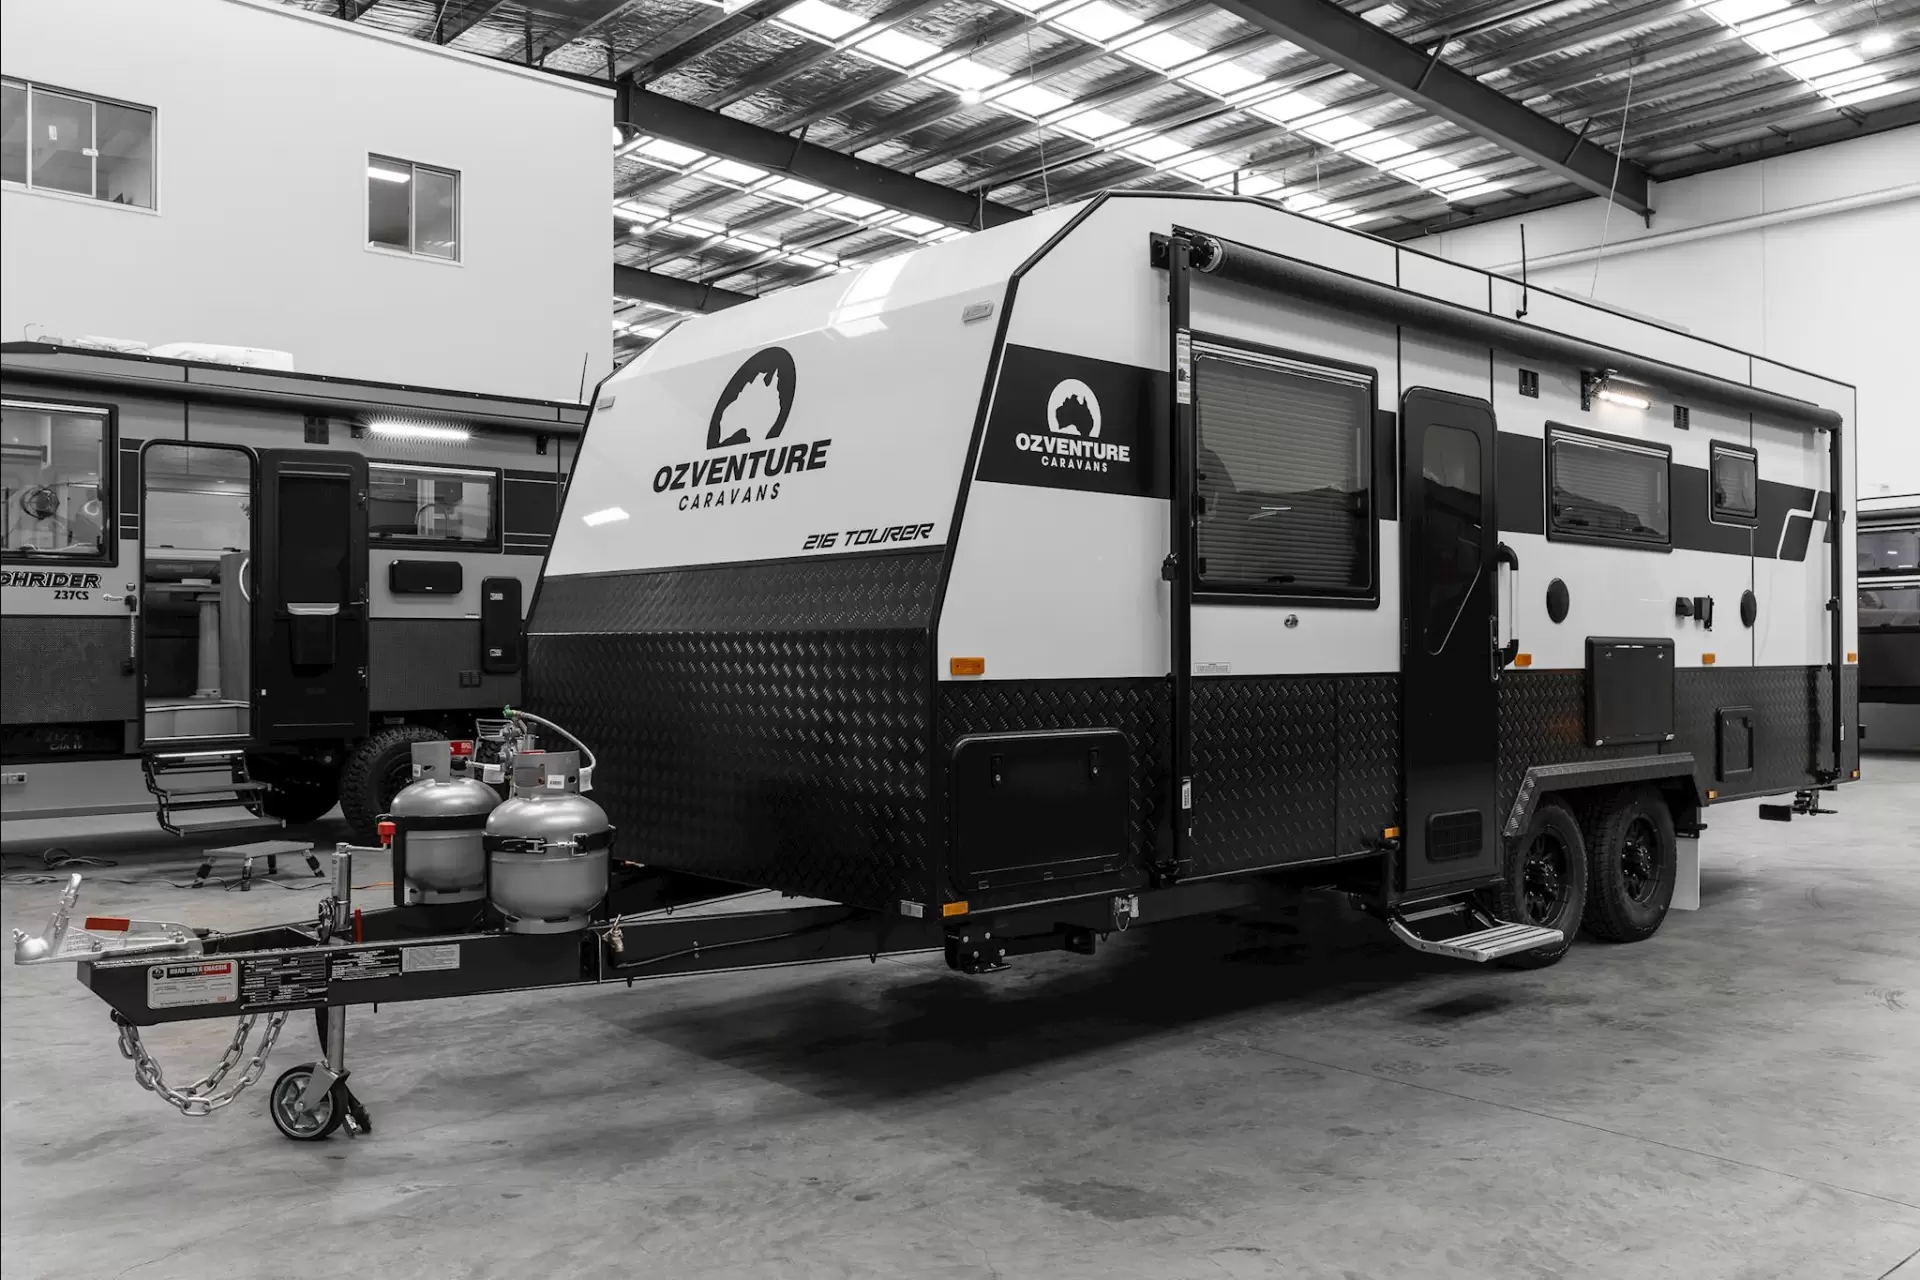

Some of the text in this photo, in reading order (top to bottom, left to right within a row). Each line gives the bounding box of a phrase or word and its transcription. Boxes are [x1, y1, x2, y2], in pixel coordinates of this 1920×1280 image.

[1015, 433, 1130, 462] OZVENTURE
[653, 439, 832, 493] OZVENTURE
[1041, 455, 1108, 473] CARAVANS
[678, 482, 781, 511] CARAVANS
[802, 523, 935, 550] 216 TOURER
[54, 590, 89, 601] 237CS
